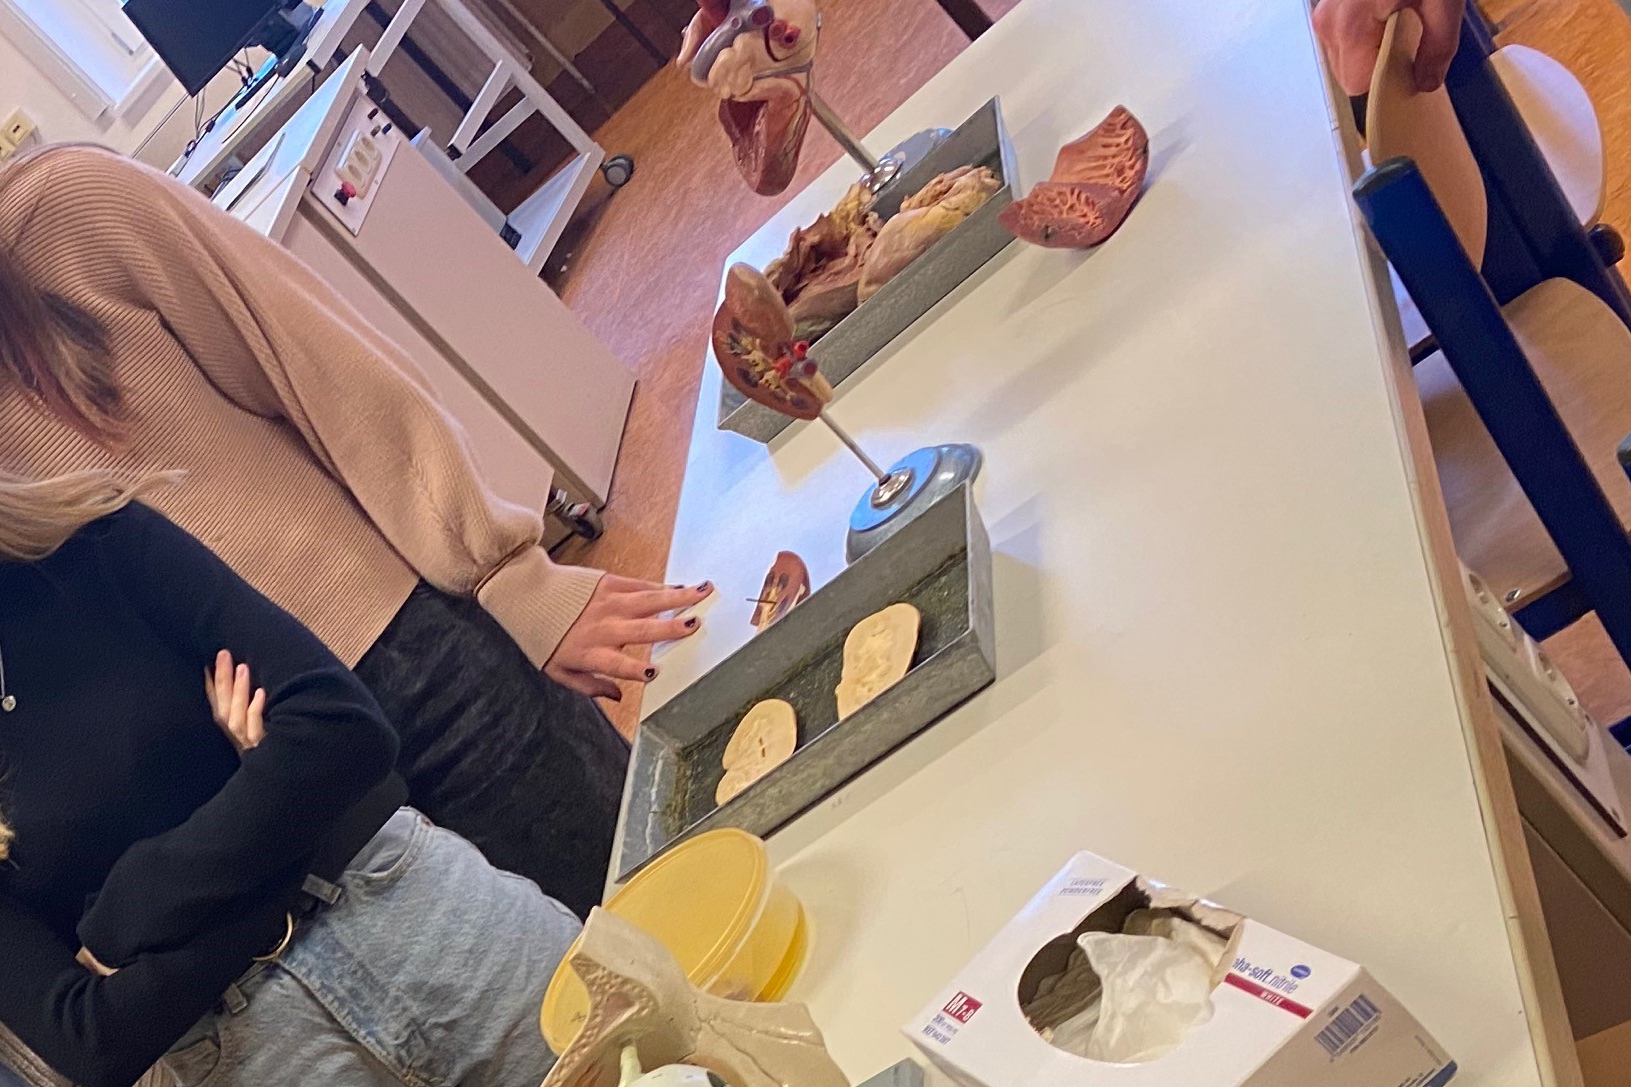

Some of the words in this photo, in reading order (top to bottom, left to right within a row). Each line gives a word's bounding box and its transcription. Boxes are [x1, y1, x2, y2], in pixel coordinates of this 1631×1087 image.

[1231, 957, 1273, 982] ha-soft
[1268, 974, 1299, 994] nitrile
[945, 993, 968, 1014] M
